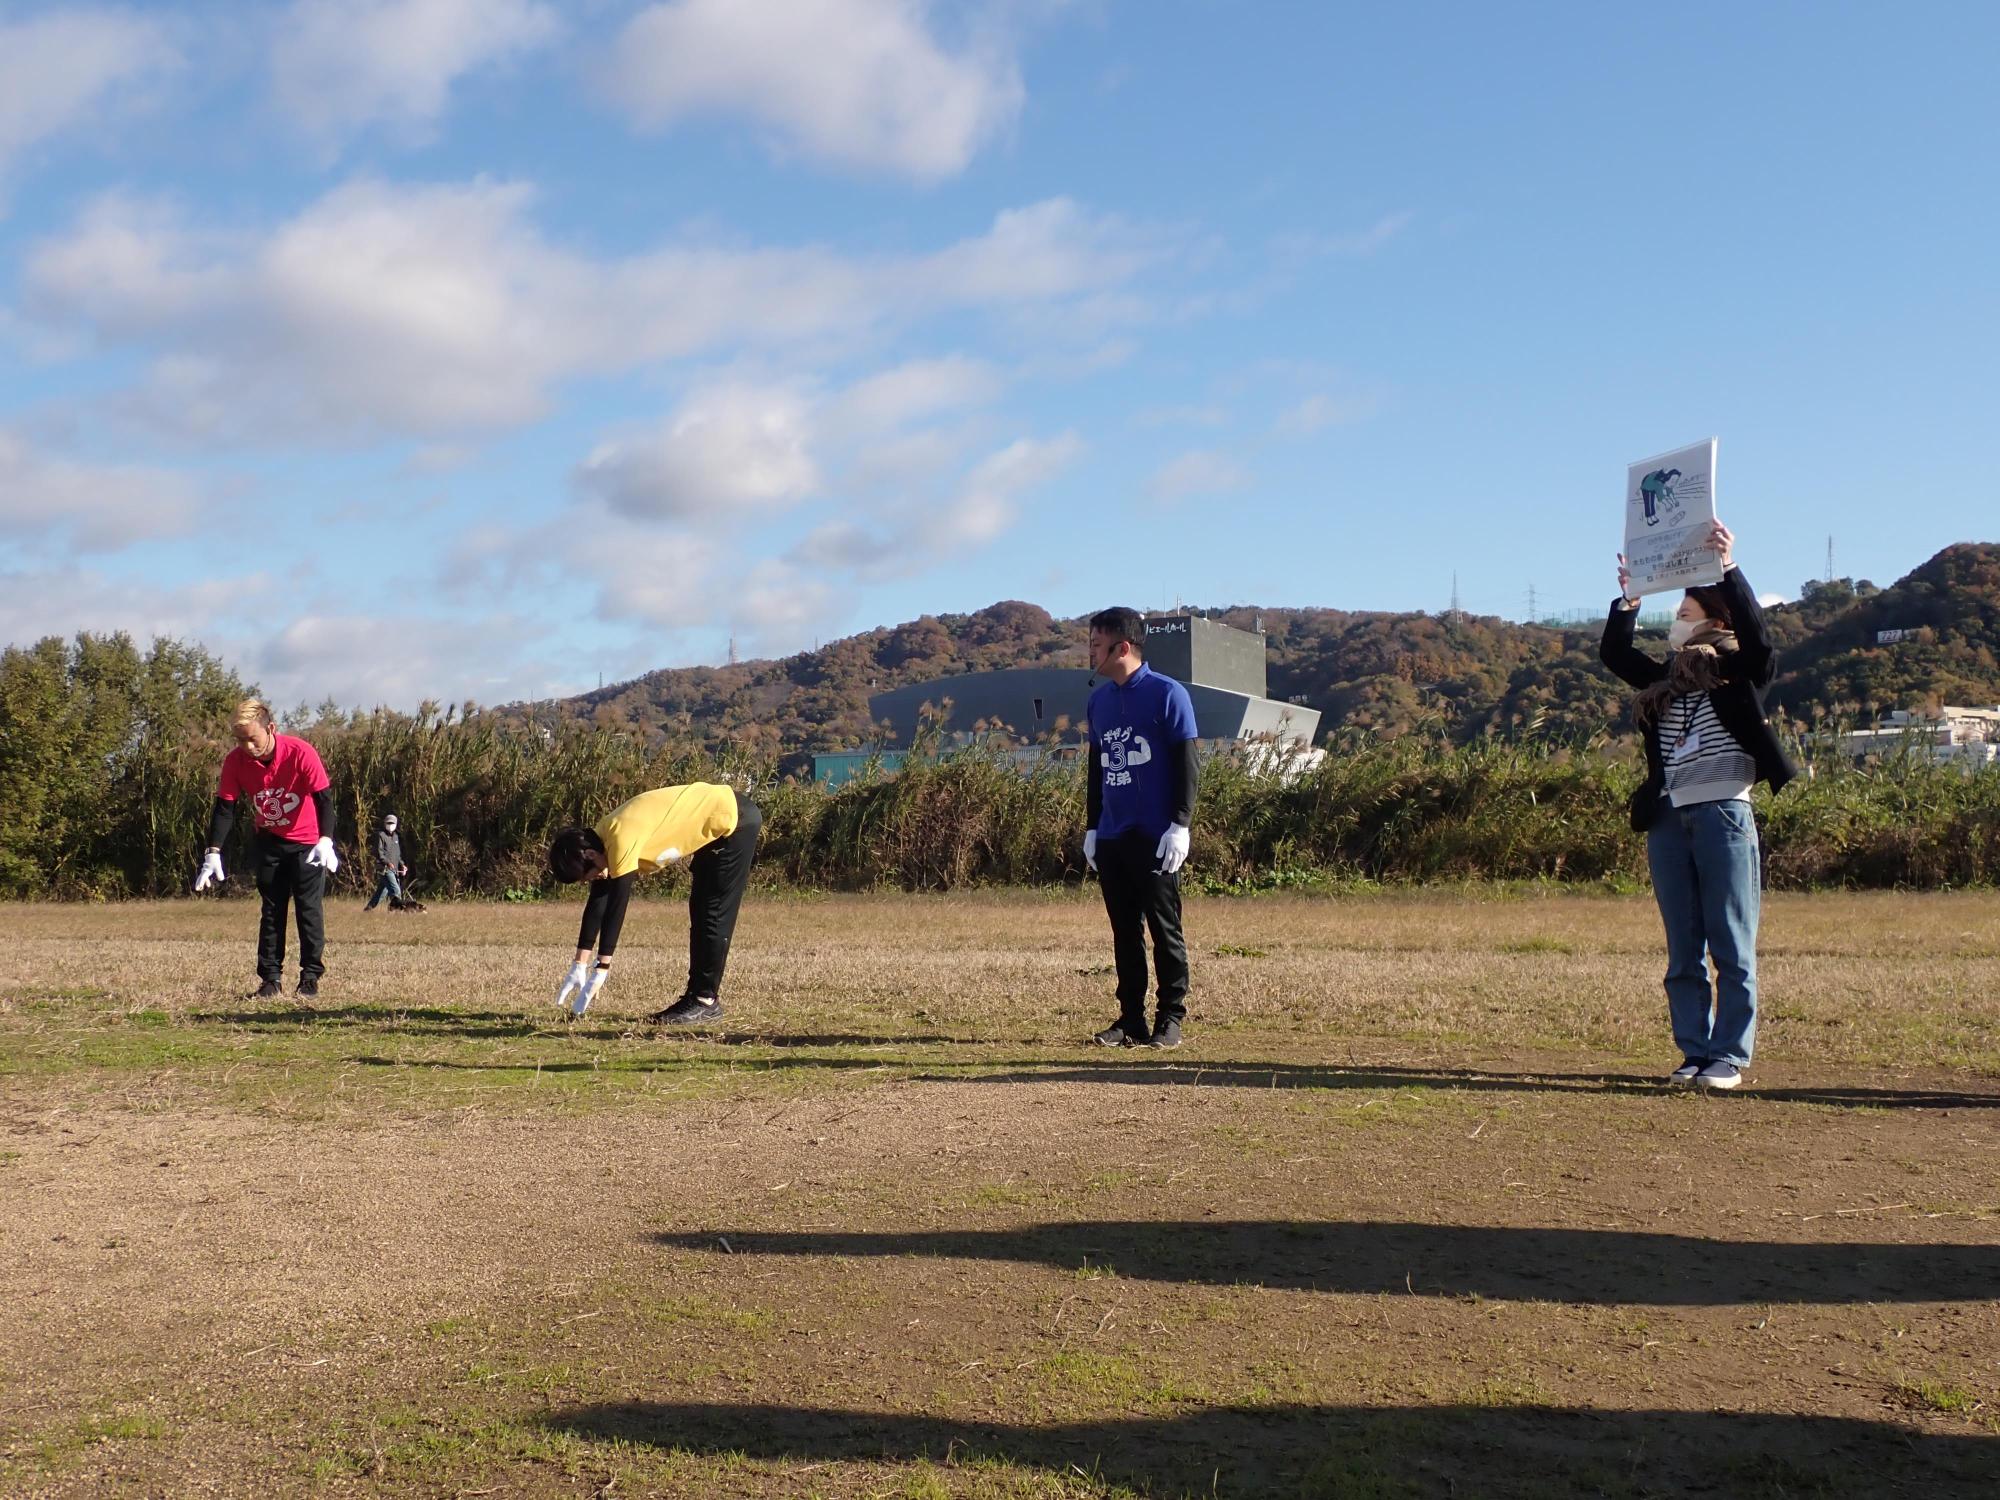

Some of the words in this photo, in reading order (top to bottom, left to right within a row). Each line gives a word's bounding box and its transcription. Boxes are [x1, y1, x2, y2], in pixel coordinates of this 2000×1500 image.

[1103, 726, 1133, 744] ギャグ
[1110, 741, 1127, 771] 3
[1105, 770, 1132, 787] 兄弟
[263, 797, 282, 820] 3
